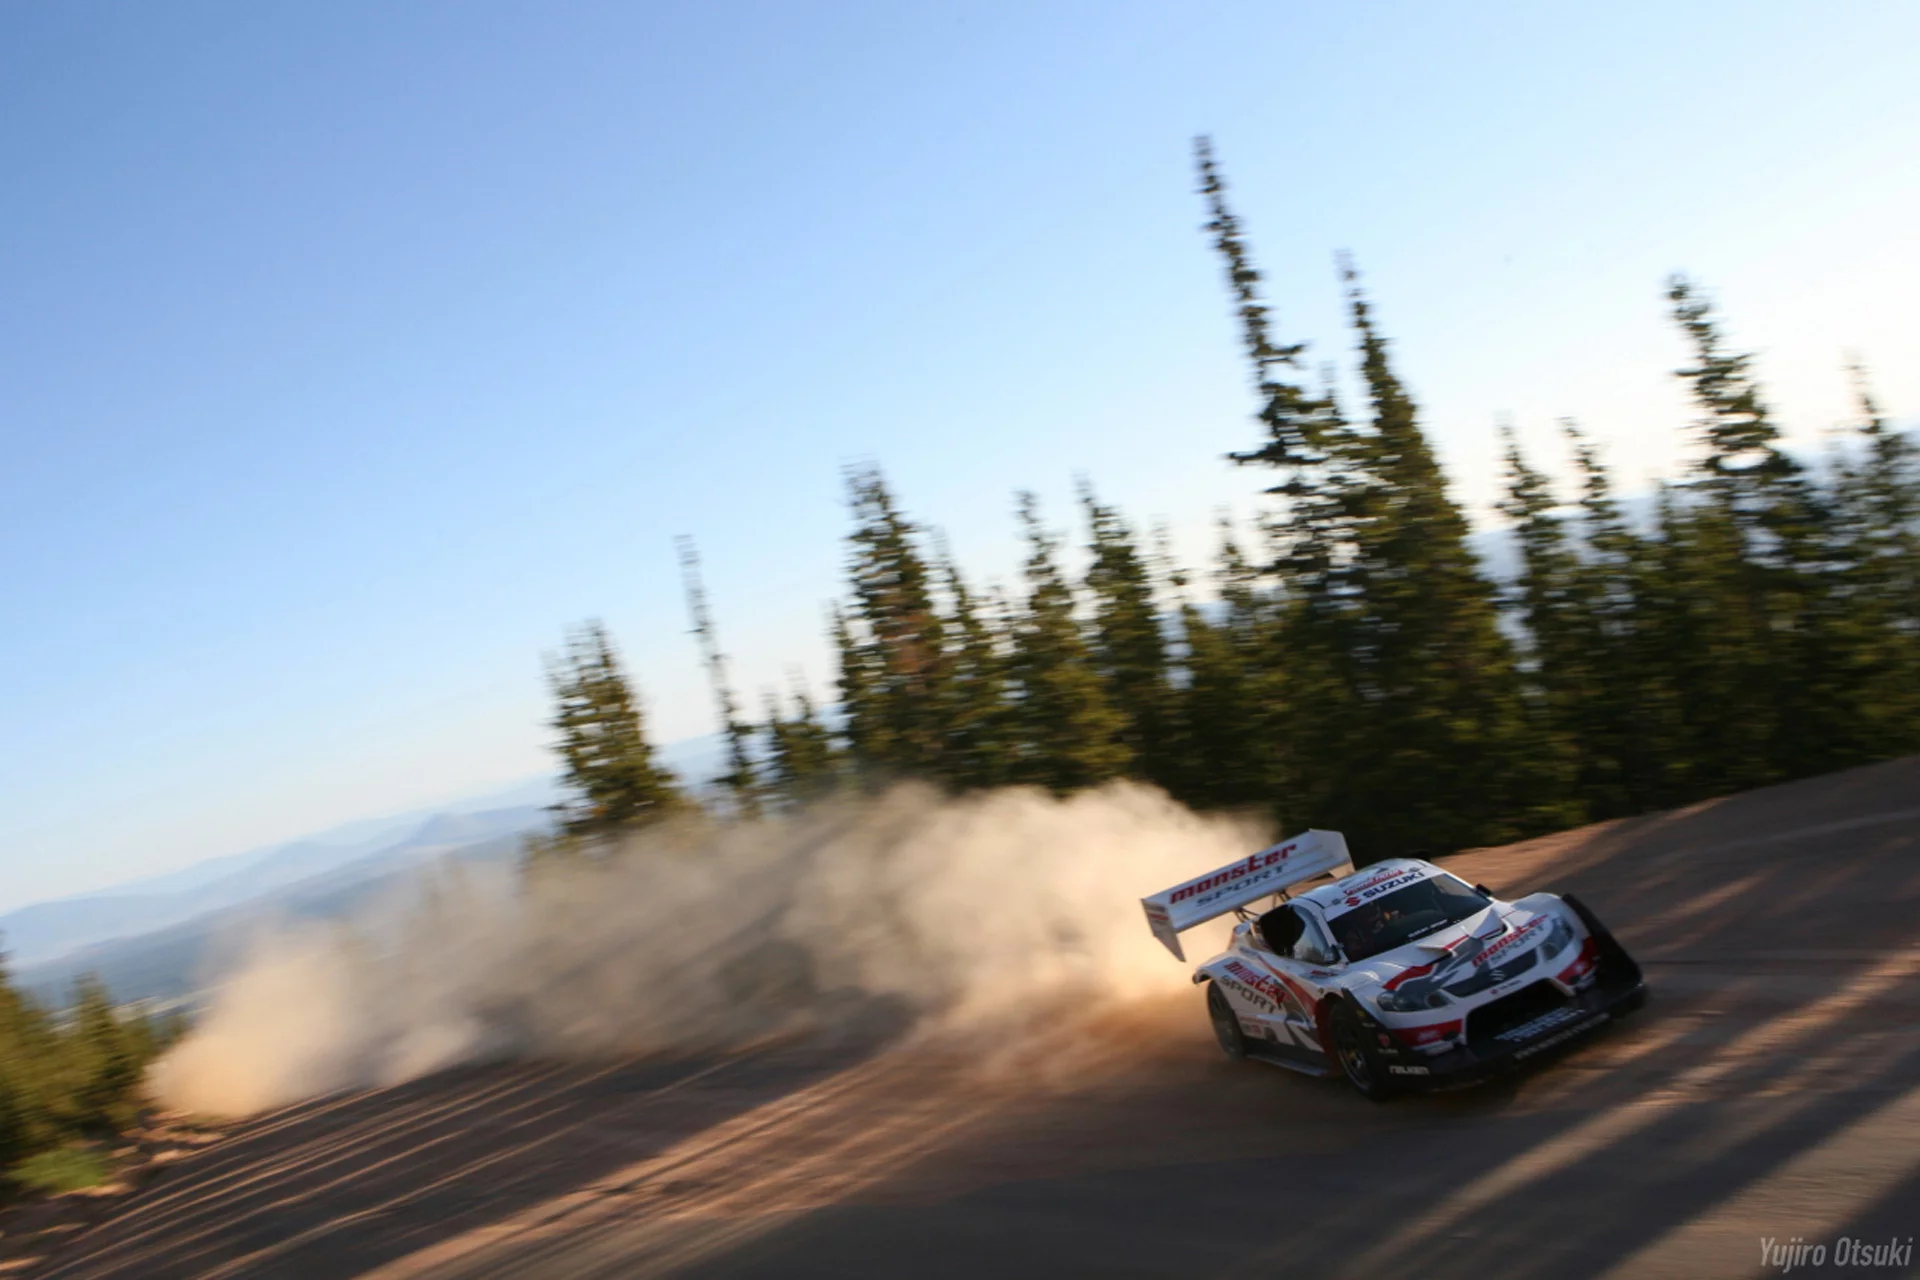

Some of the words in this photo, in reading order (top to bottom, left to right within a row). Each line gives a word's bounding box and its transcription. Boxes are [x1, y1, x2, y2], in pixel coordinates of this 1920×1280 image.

[1168, 843, 1297, 905] monster
[1195, 862, 1288, 908] SPORT
[1363, 872, 1426, 898] SUZUKI
[1472, 914, 1549, 967] monster
[1220, 975, 1276, 1014] SPORT
